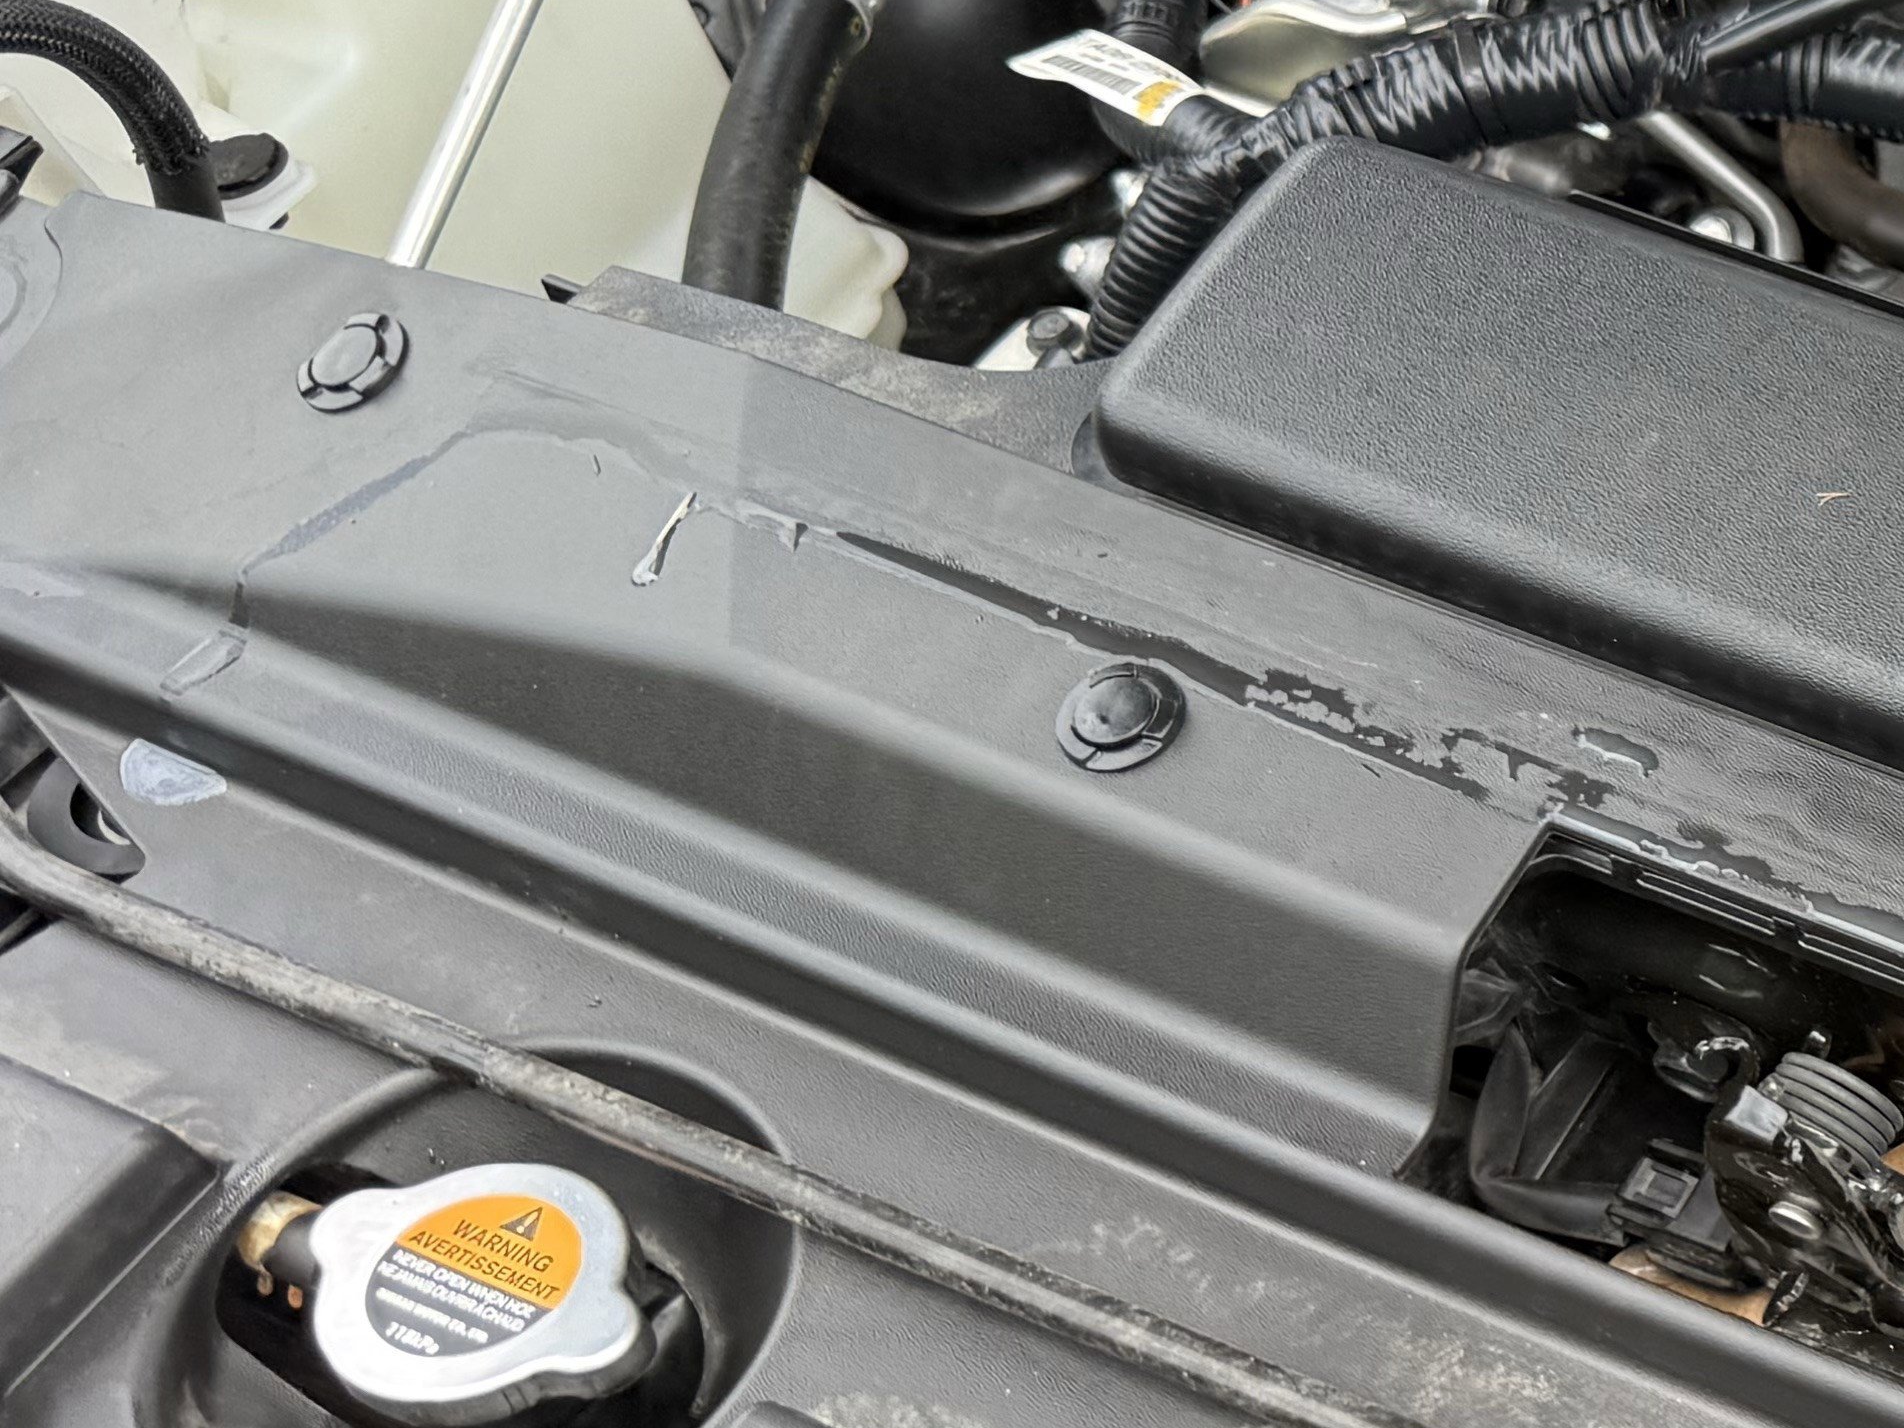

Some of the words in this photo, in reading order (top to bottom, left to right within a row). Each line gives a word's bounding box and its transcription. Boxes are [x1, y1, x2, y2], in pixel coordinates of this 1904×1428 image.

[407, 1227, 561, 1302] AVERTISSEMENT
[451, 1219, 555, 1272] WARNING
[390, 1249, 437, 1276] NEVER
[430, 1266, 471, 1291] OPEN
[464, 1281, 510, 1308] WHEN
